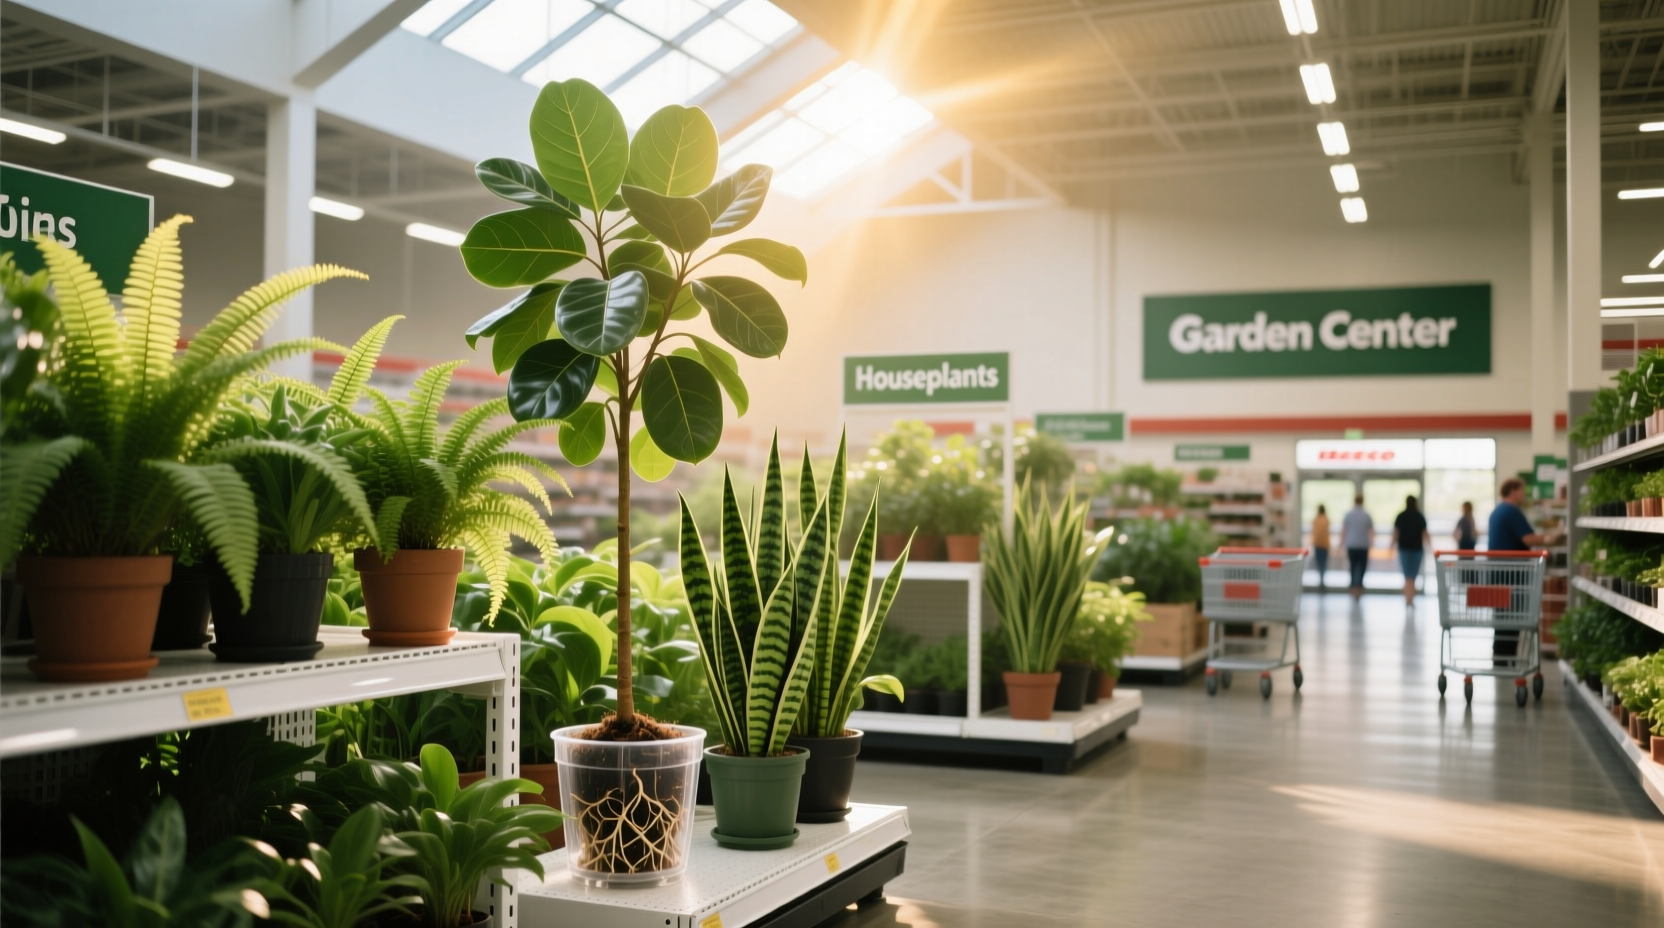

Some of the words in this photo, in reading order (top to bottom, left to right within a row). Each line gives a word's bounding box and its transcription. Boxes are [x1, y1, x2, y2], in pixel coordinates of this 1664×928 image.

[1168, 311, 1314, 354] Garden
[1319, 310, 1457, 351] Center
[855, 361, 999, 396] Houseplants
